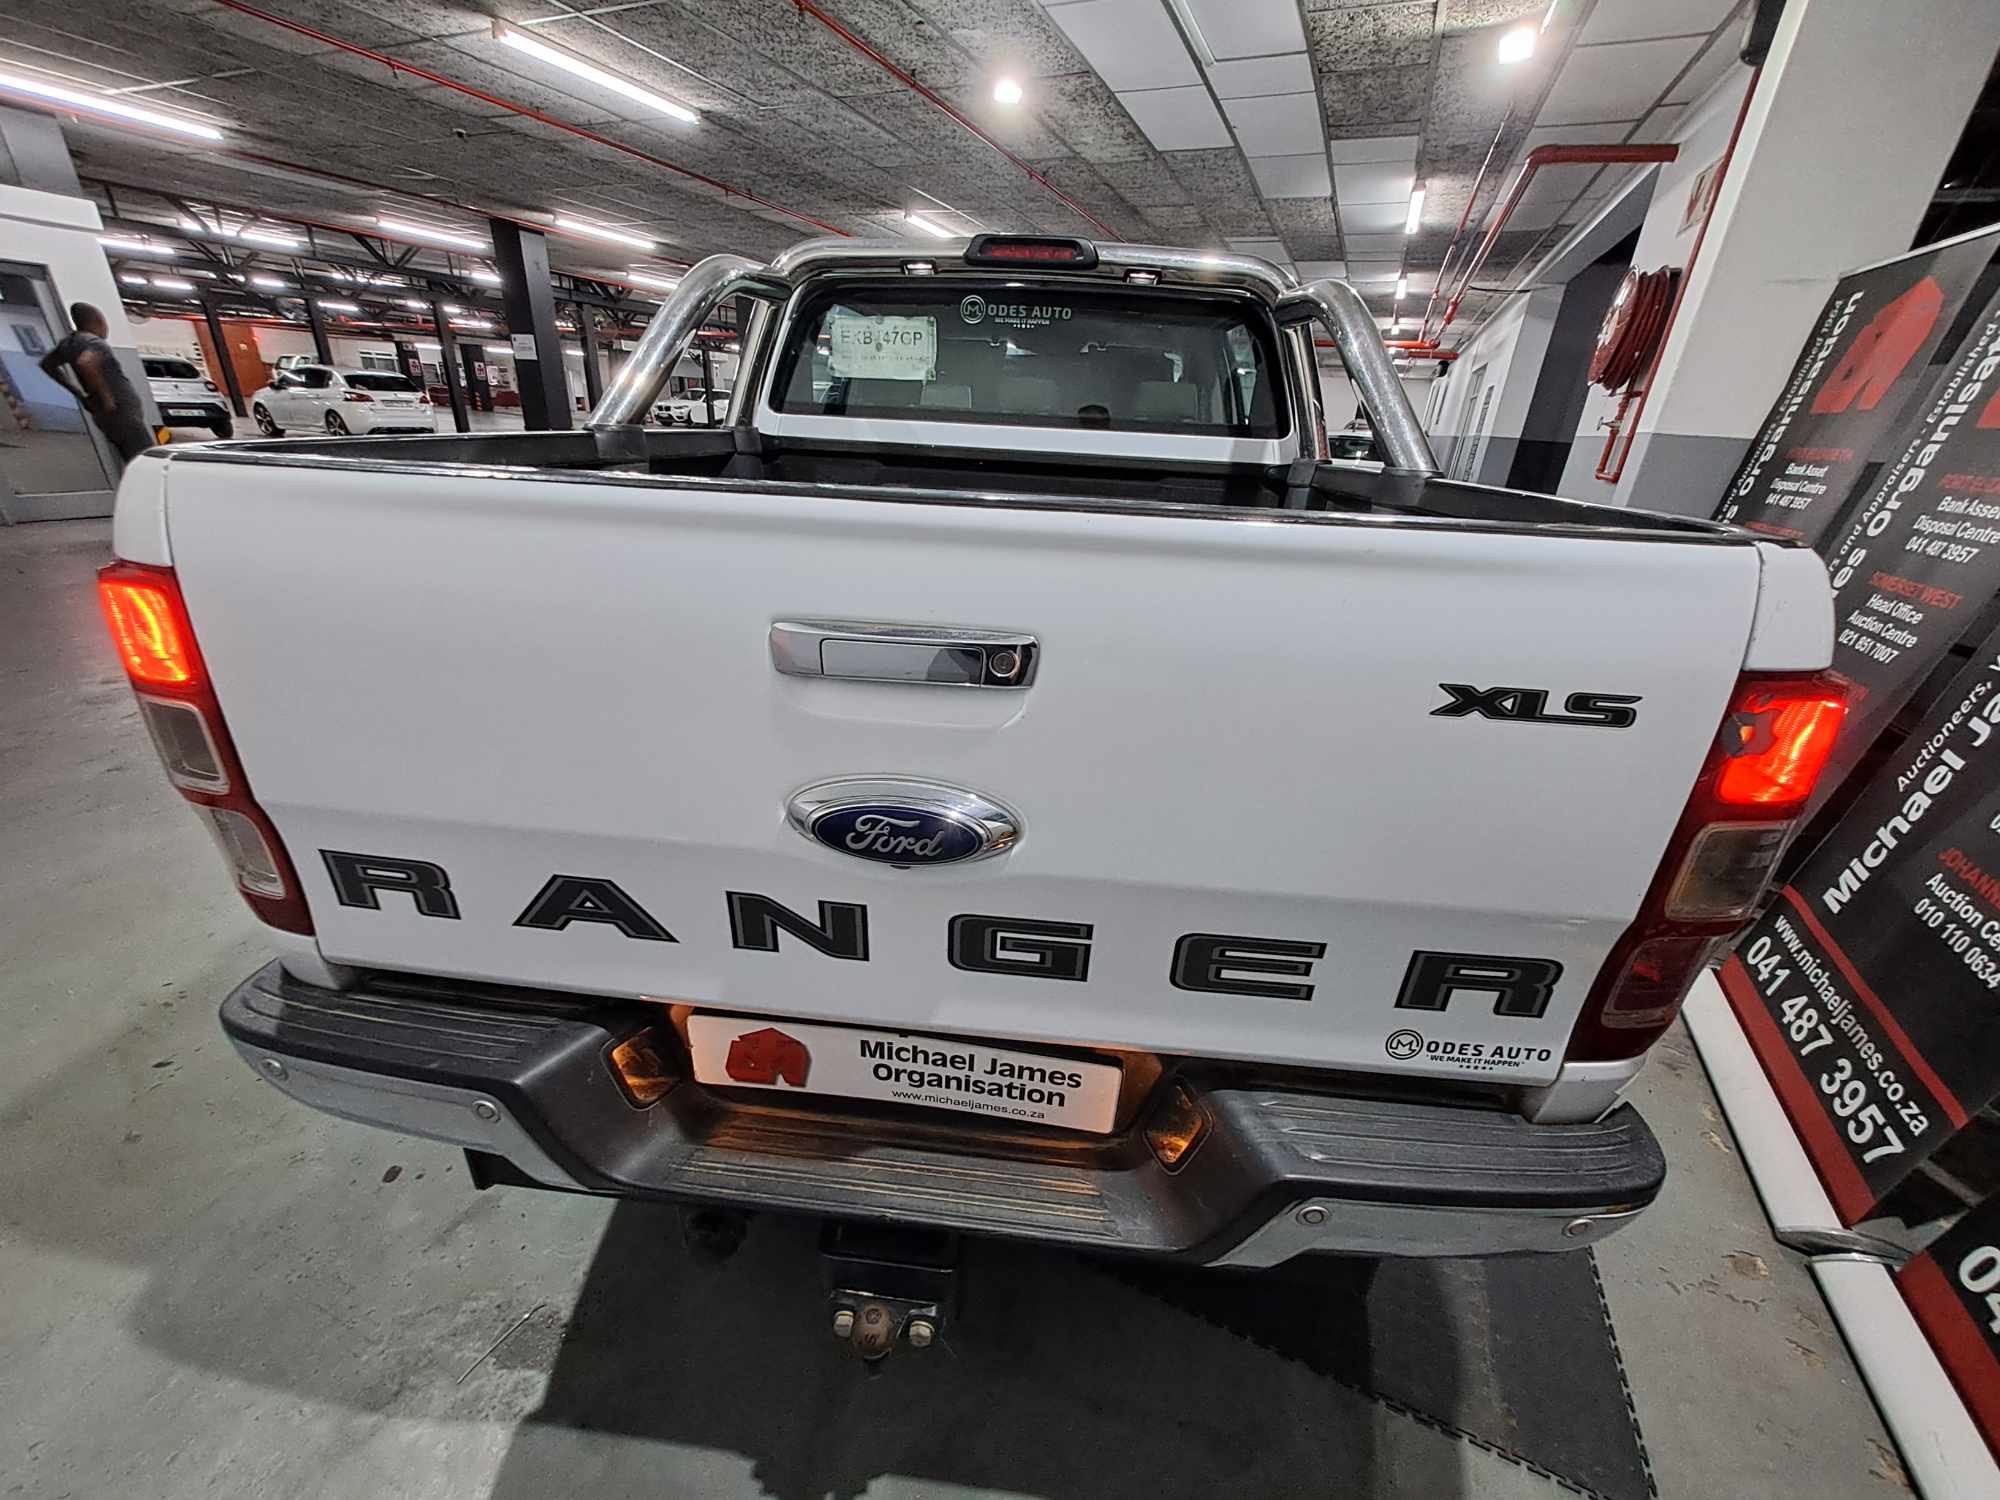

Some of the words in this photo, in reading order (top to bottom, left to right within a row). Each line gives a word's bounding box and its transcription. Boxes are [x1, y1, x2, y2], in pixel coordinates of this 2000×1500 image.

[1032, 306, 1072, 320] AUTO
[1739, 290, 1865, 496] Organisation
[1840, 524, 1862, 554] and
[1863, 437, 1921, 523] Appraisers
[1926, 323, 1998, 424] Established
[1937, 496, 1969, 514] Bank
[1912, 515, 1962, 535] Disposal
[1956, 521, 2000, 544] Centre
[1942, 543, 1980, 563] 3957
[1847, 610, 1883, 634] Auction
[1881, 623, 1918, 648] Centre
[1866, 593, 1897, 614] Head
[1891, 602, 1924, 624] Office
[1838, 629, 1860, 646] 021
[1869, 643, 1899, 664] 7007
[1430, 684, 1643, 728] XLS
[1896, 681, 1992, 792] Auctioneers,
[845, 814, 945, 857] Ford
[1822, 749, 1966, 914] Michael
[1925, 872, 1984, 928] Auction
[319, 849, 1564, 1019] RANGER
[1914, 898, 1945, 928] 010
[1940, 923, 1971, 952] 110
[1964, 947, 2000, 989] 0634
[1775, 913, 1929, 1136] www.michaeljames.co.za
[860, 1039, 975, 1072] Michael
[984, 1058, 1082, 1088] James
[1490, 1046, 1551, 1062] AUTO
[1746, 934, 1790, 996] 041
[1780, 994, 1835, 1057] 487
[1819, 1057, 1904, 1164] 3957
[873, 1063, 1066, 1107] Organisation
[892, 1089, 1045, 1119] www.michaeljames.co.za
